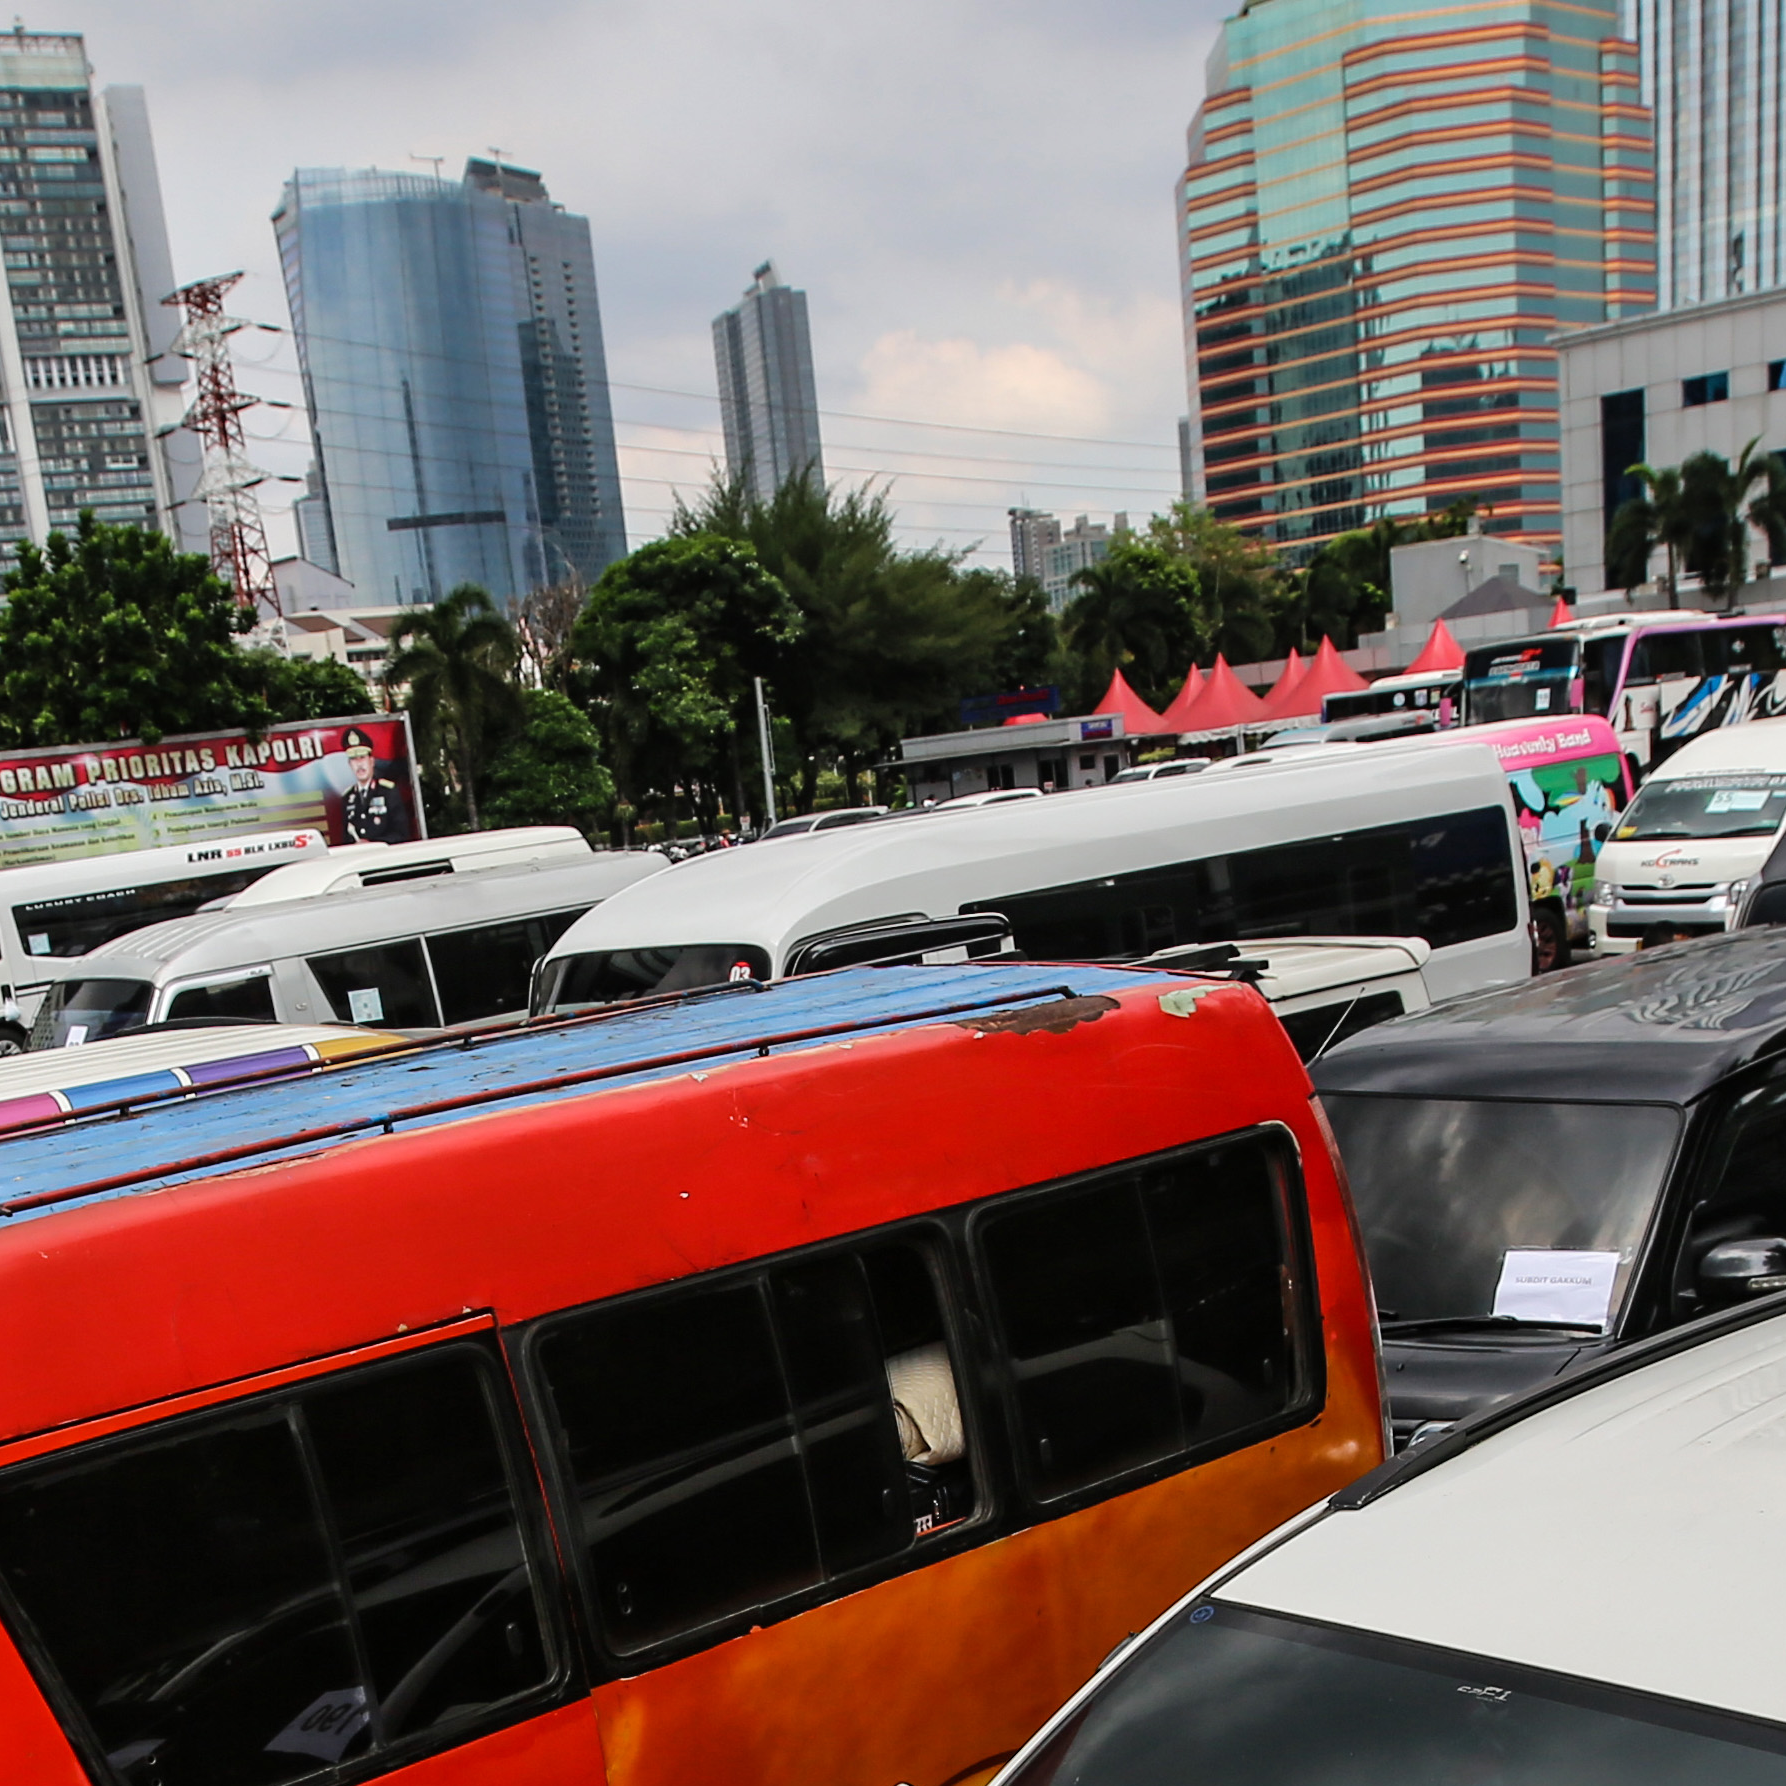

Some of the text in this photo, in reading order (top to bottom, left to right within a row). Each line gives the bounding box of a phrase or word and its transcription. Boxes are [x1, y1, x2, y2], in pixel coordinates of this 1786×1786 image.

[1558, 729, 1592, 748] Band
[85, 747, 216, 785] PRIORITAS
[225, 735, 324, 769] KAPOLRI
[0, 798, 65, 820] Jenderal
[115, 787, 144, 805] Drs.
[148, 783, 190, 802] Idham
[194, 777, 228, 796] Azis,
[25, 888, 136, 911] LUXURY COACH
[1516, 1276, 1592, 1286] SUBDIT GAKKUM
